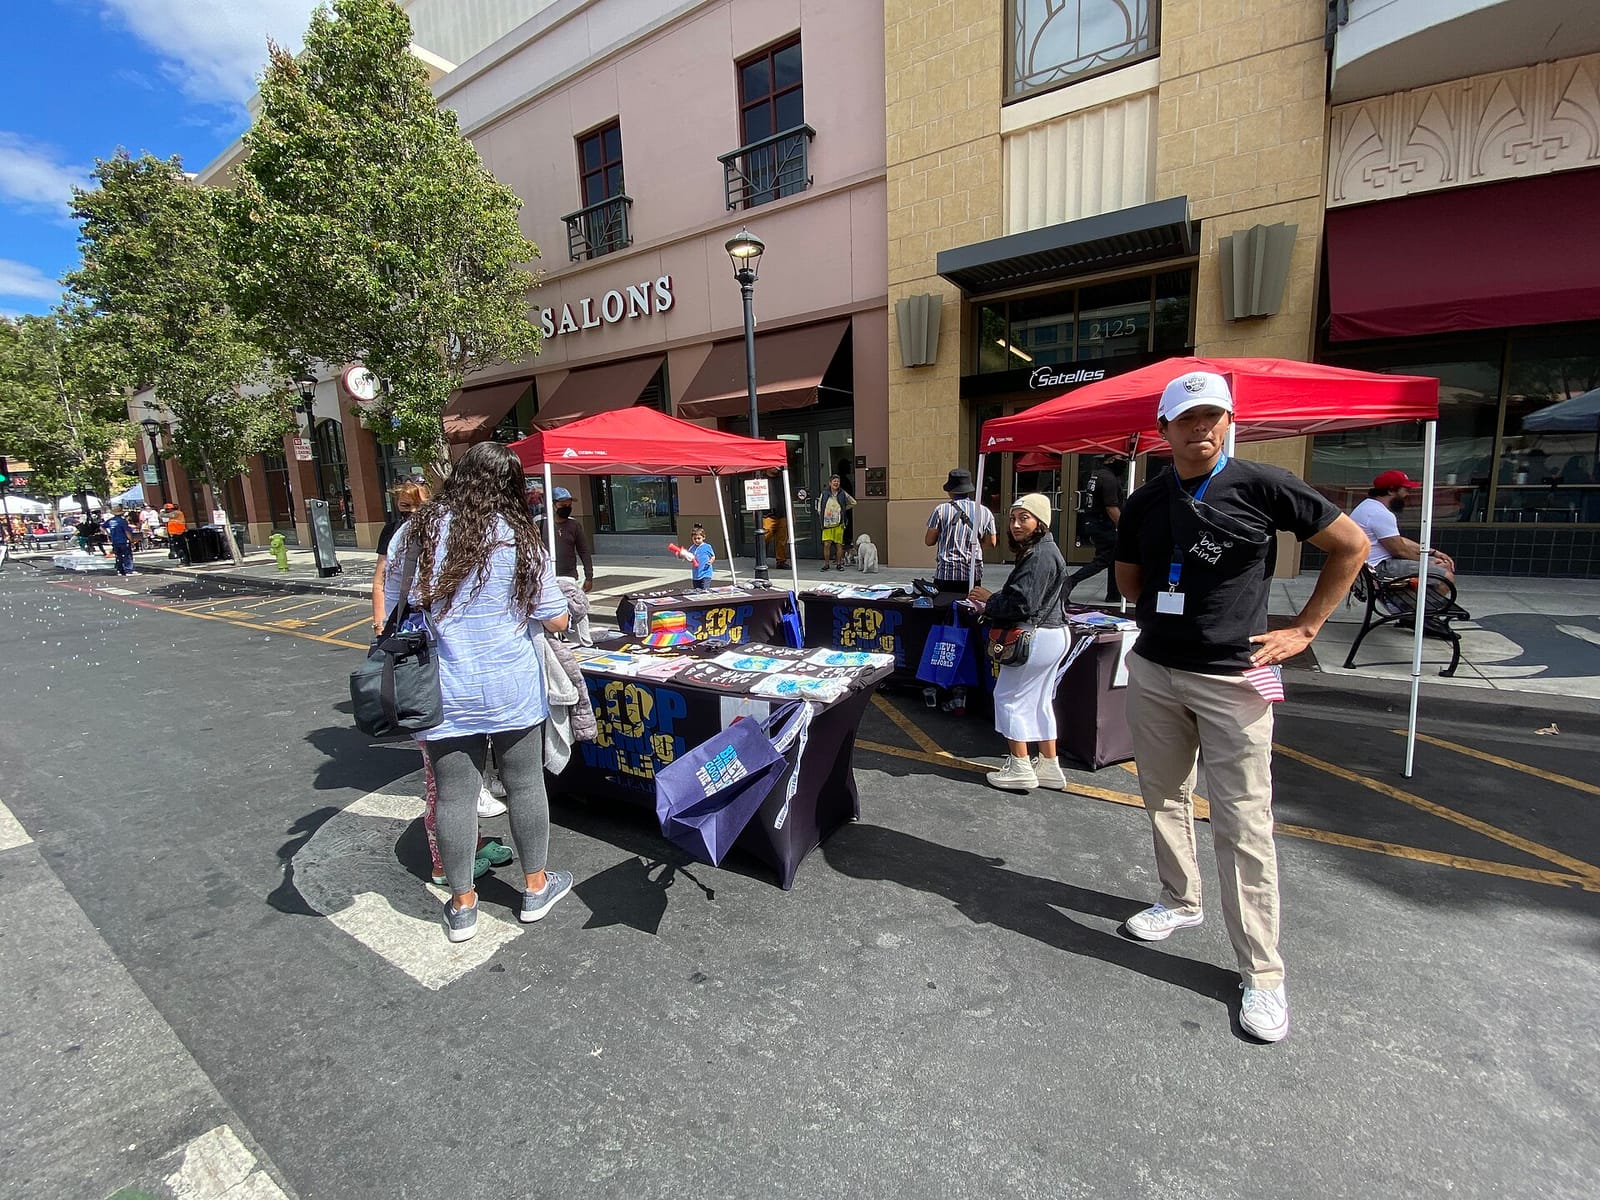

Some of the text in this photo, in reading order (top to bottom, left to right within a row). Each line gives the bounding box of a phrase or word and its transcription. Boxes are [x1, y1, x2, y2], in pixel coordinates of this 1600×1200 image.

[540, 275, 674, 339] SALONS
[1089, 317, 1137, 341] 2125
[1037, 369, 1105, 387] Satelles
[1200, 535, 1222, 553] bee
